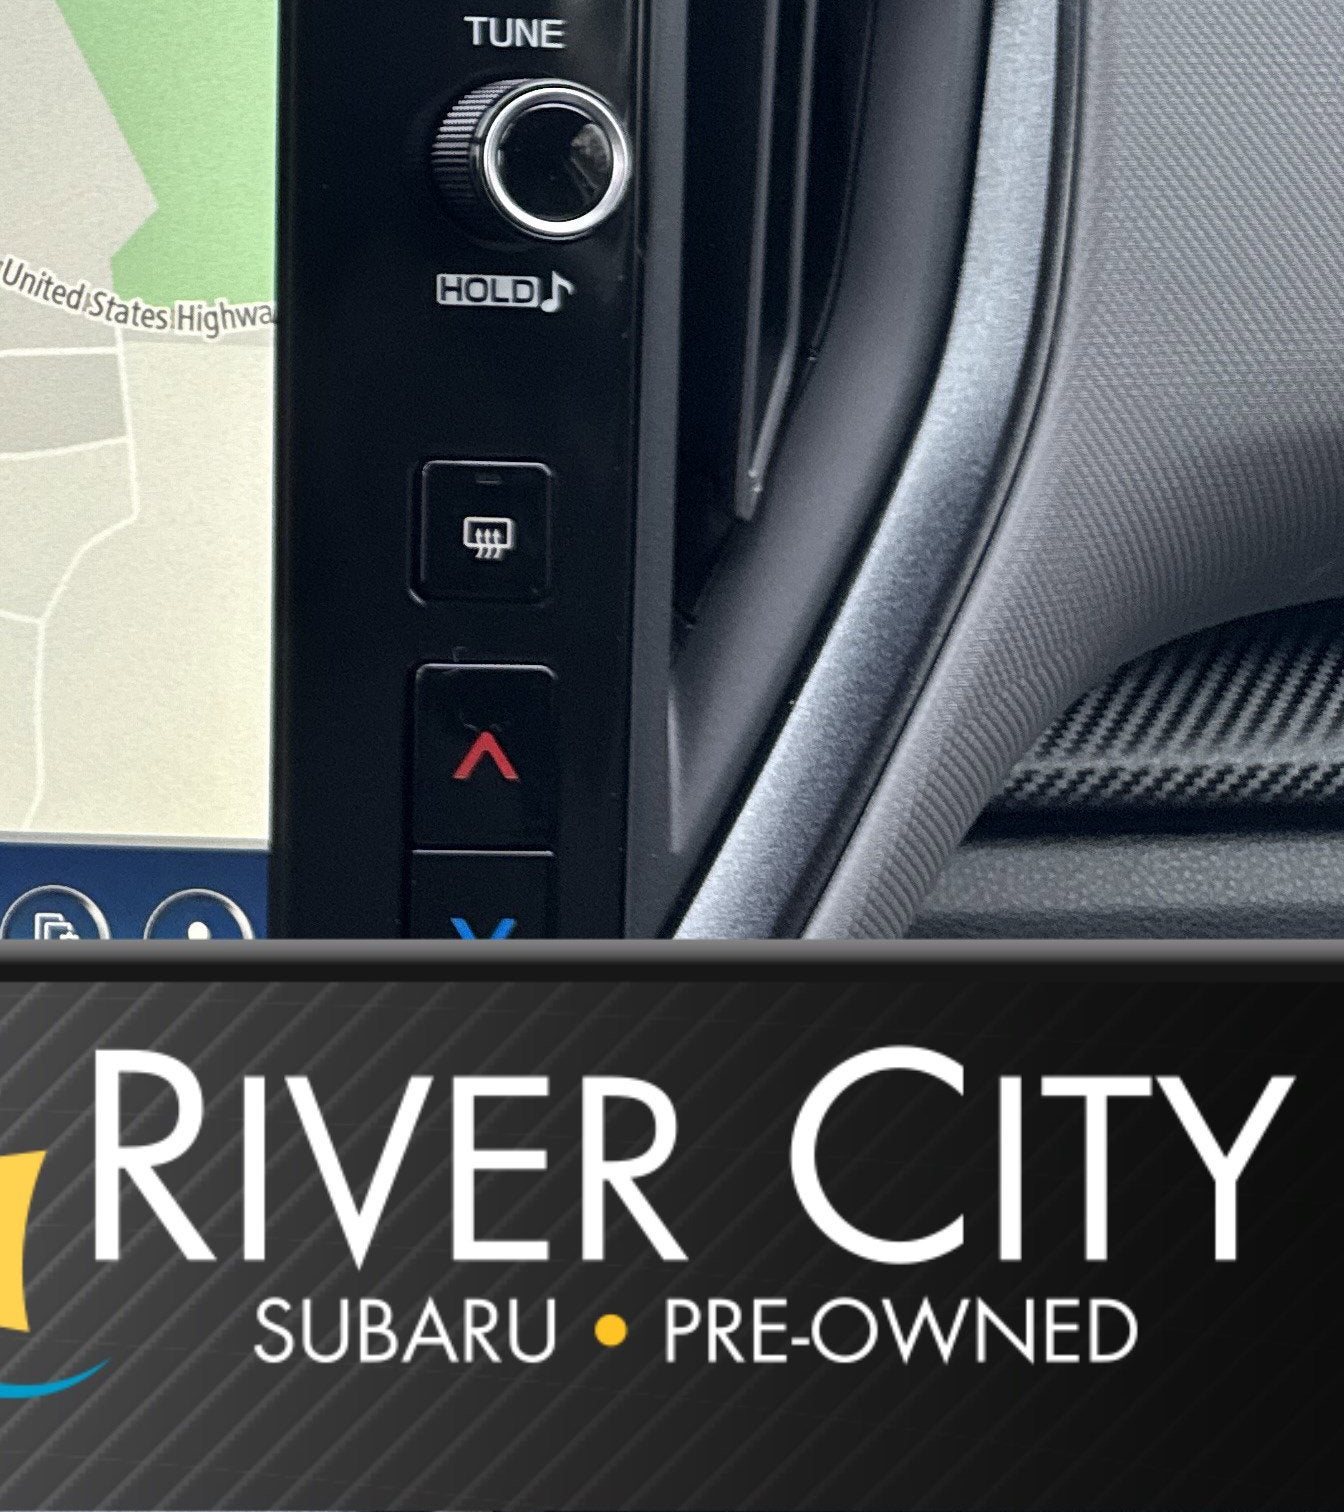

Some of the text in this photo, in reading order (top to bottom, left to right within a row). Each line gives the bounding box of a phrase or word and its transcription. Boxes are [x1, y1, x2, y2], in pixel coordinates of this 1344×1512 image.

[463, 15, 567, 49] TUNE
[1, 258, 86, 311] United
[88, 290, 168, 330] States
[438, 276, 538, 305] HOLD
